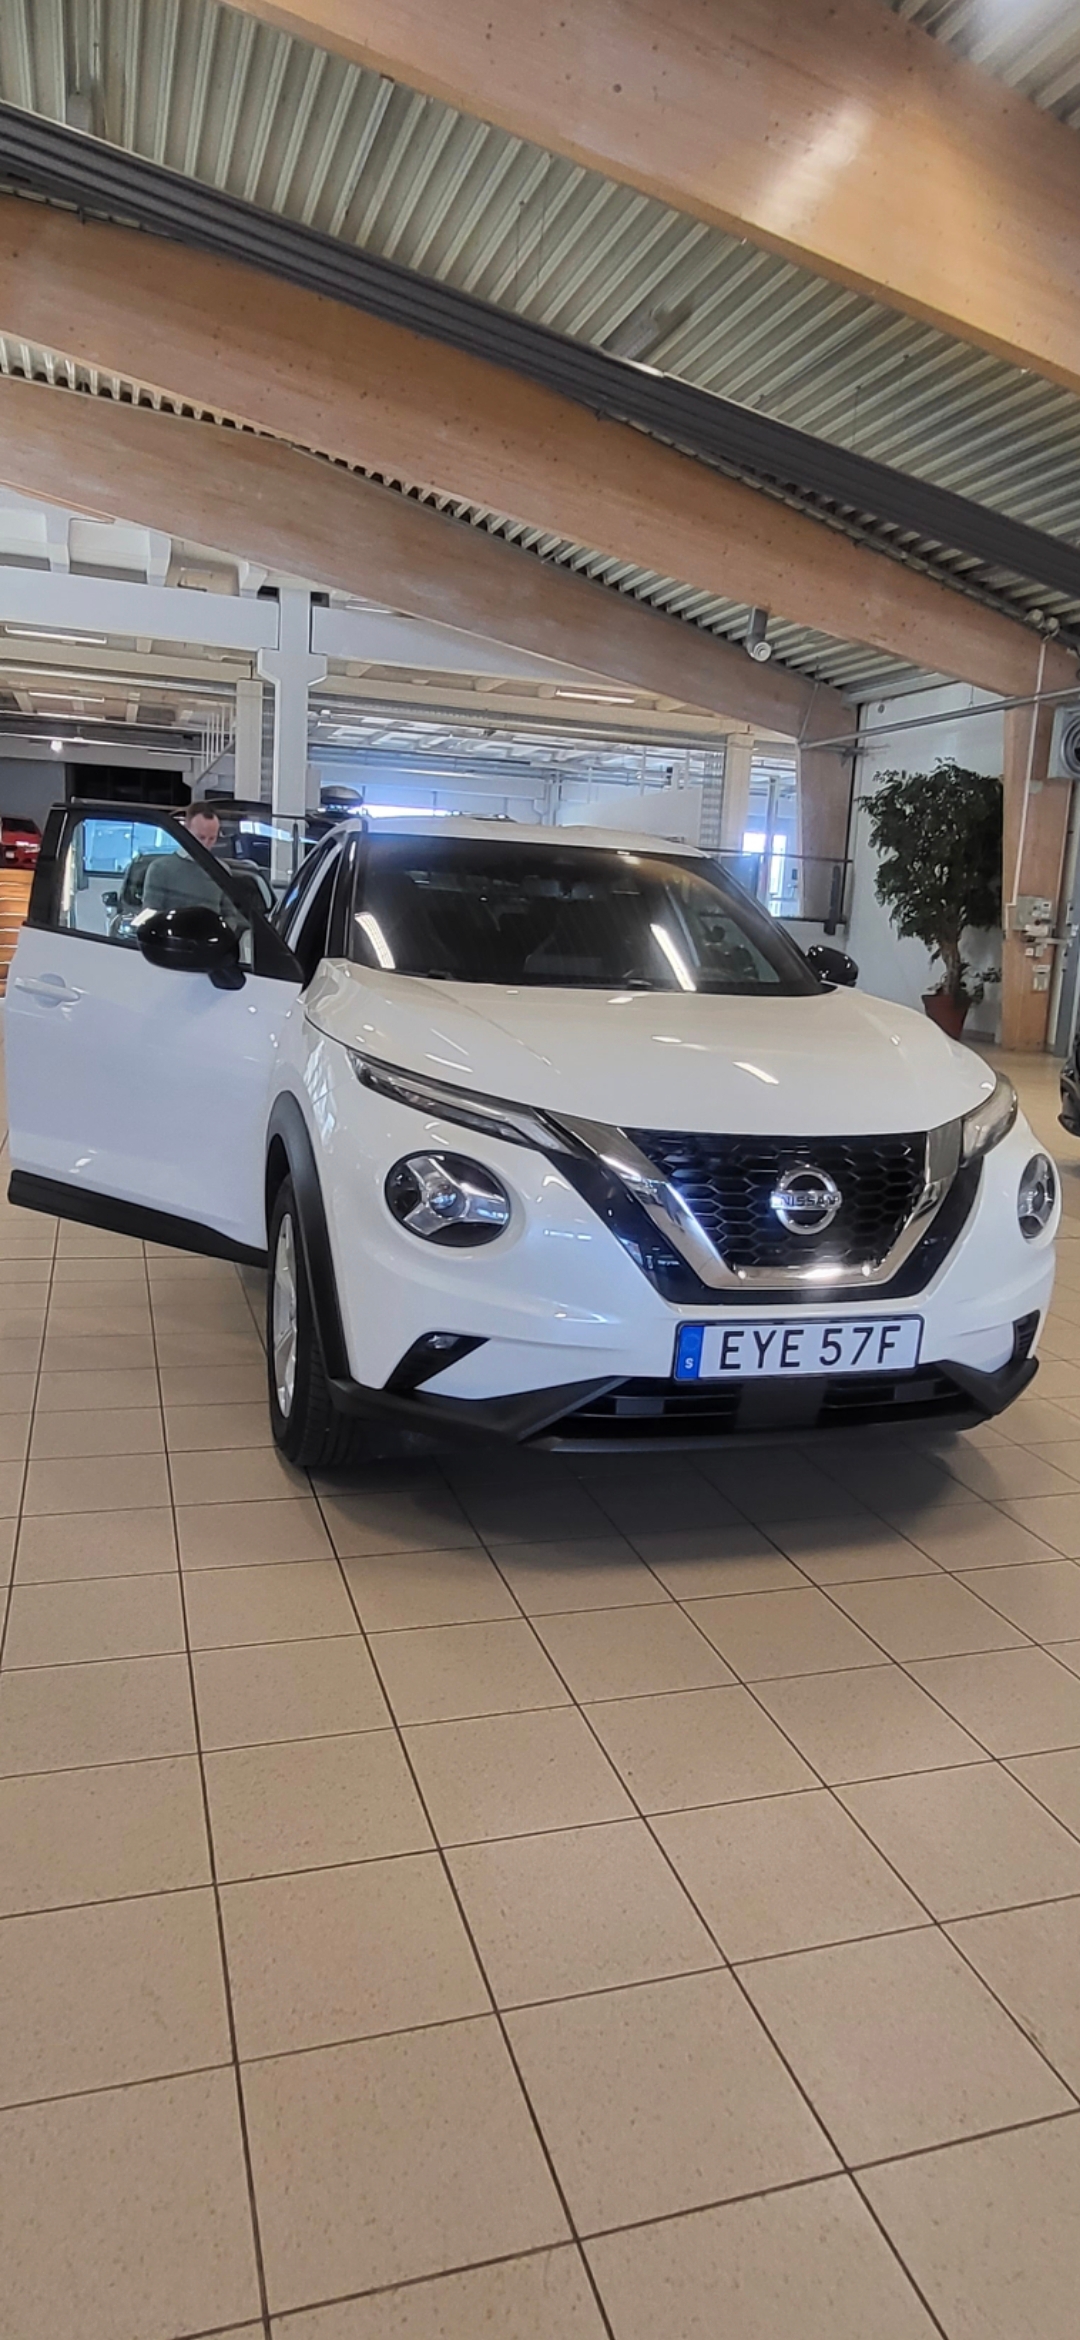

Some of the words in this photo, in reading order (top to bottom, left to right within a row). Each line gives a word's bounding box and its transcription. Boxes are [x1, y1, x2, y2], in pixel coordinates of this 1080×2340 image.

[781, 1194, 837, 1207] NISSAN
[719, 1329, 804, 1370] EYE
[819, 1325, 901, 1366] 57F
[684, 1357, 694, 1369] S
